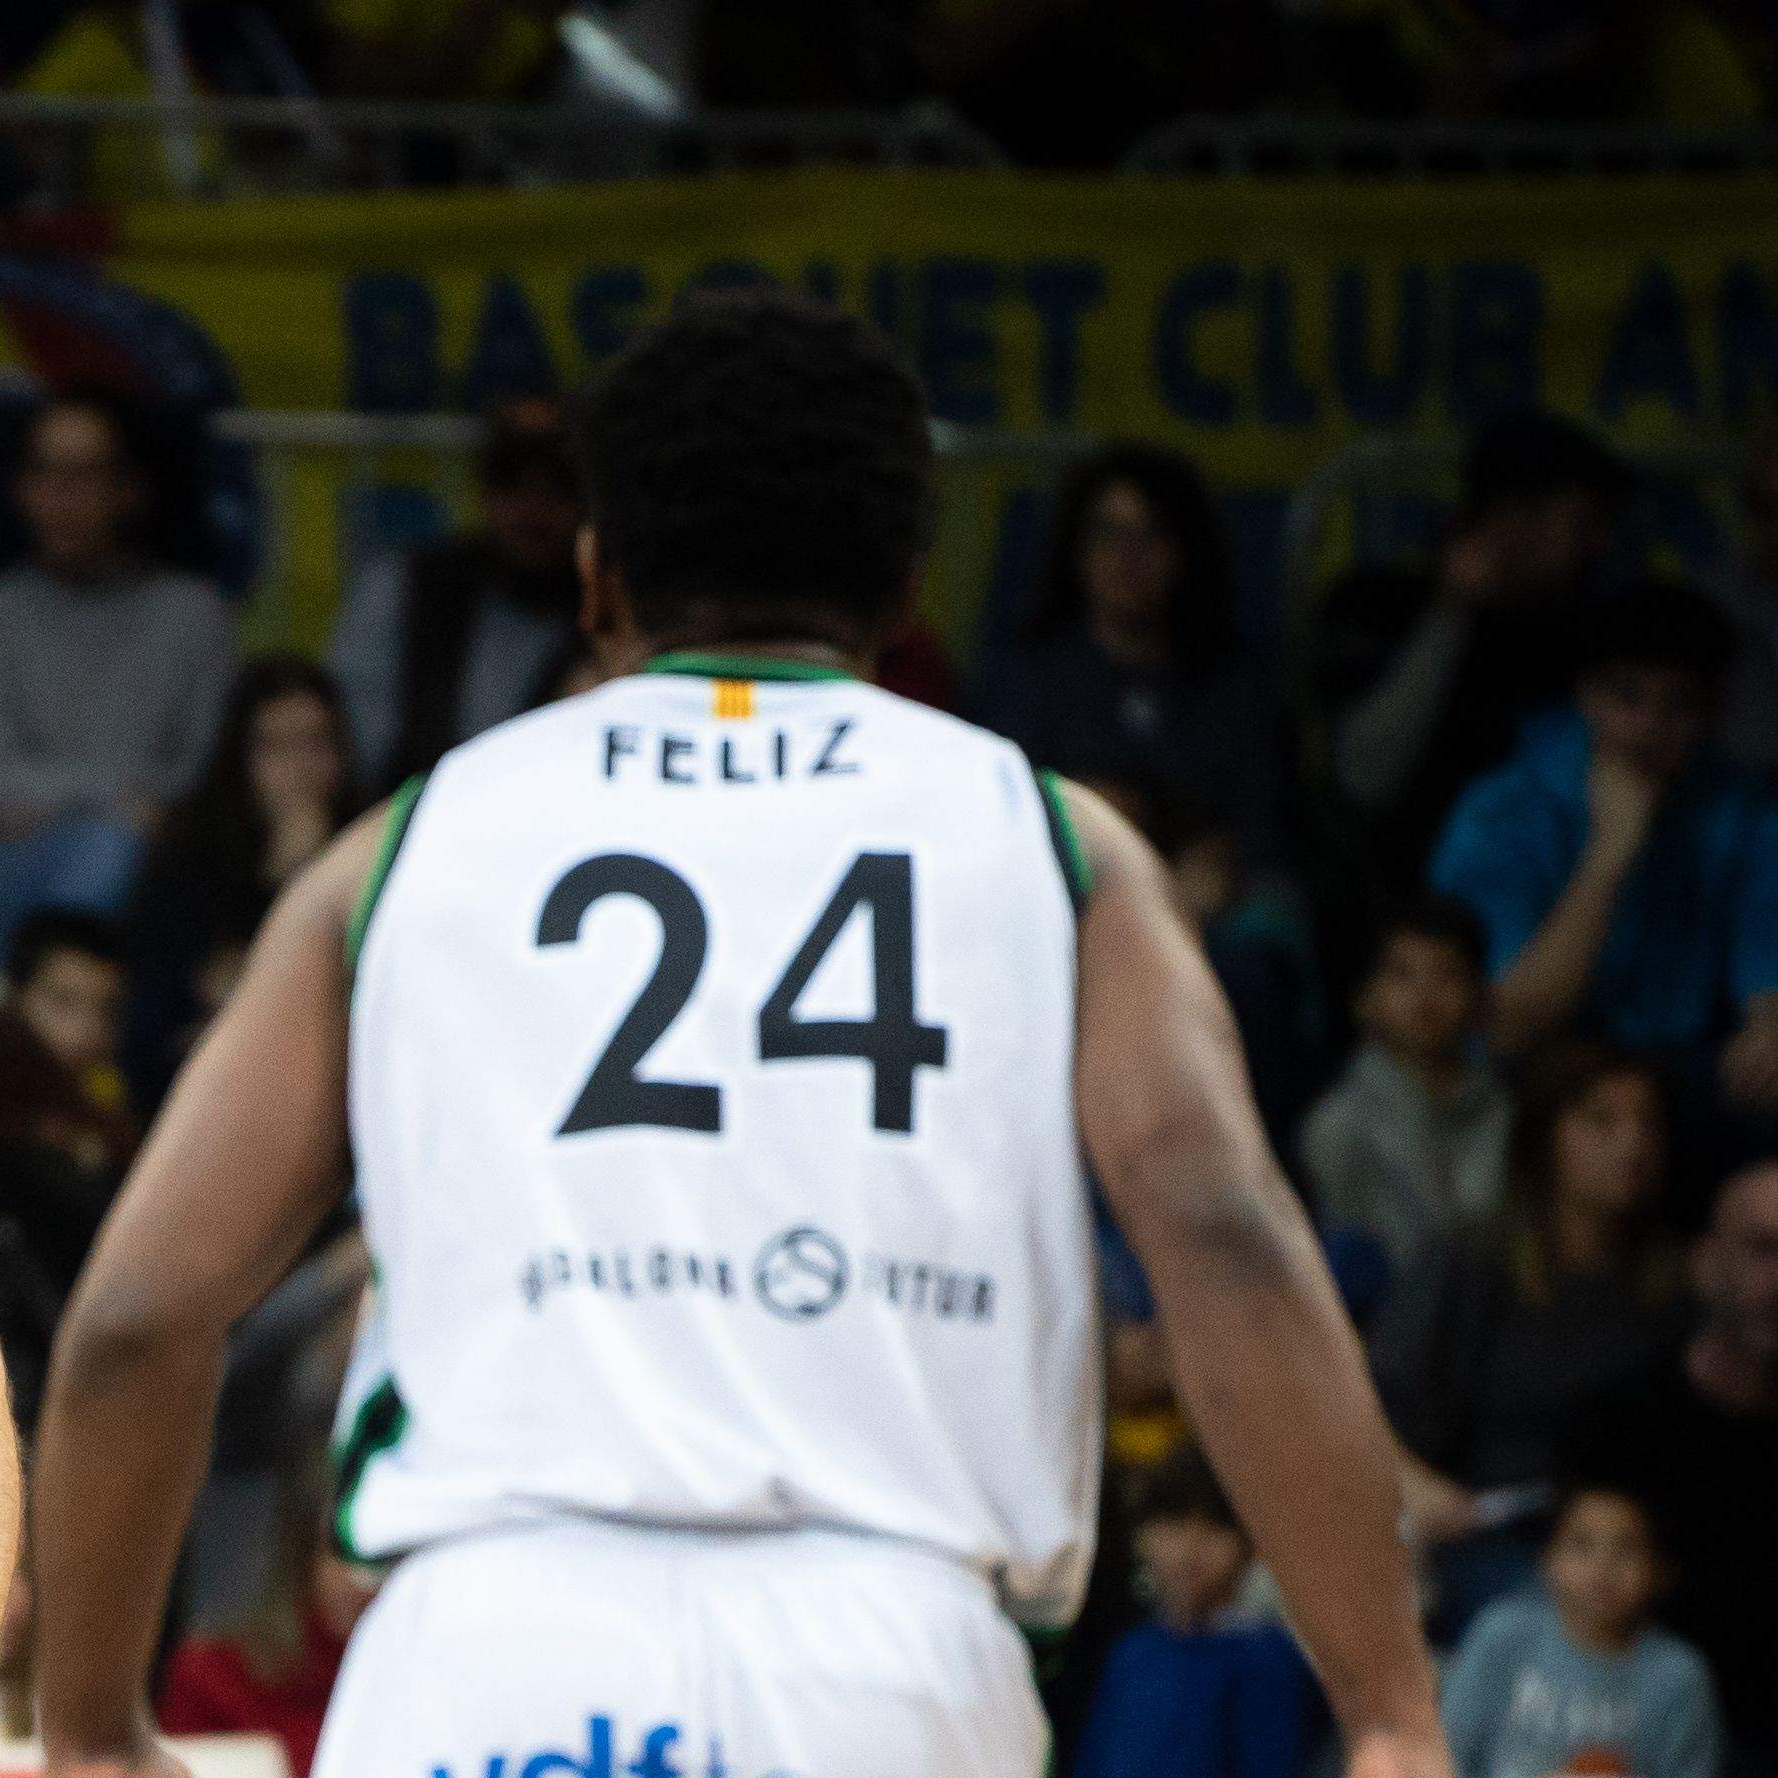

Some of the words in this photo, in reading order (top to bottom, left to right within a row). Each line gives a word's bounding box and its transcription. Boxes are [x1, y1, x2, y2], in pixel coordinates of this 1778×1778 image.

[1151, 260, 1538, 425] CLUB
[601, 717, 869, 785] FELIZ
[533, 850, 951, 1141] 24
